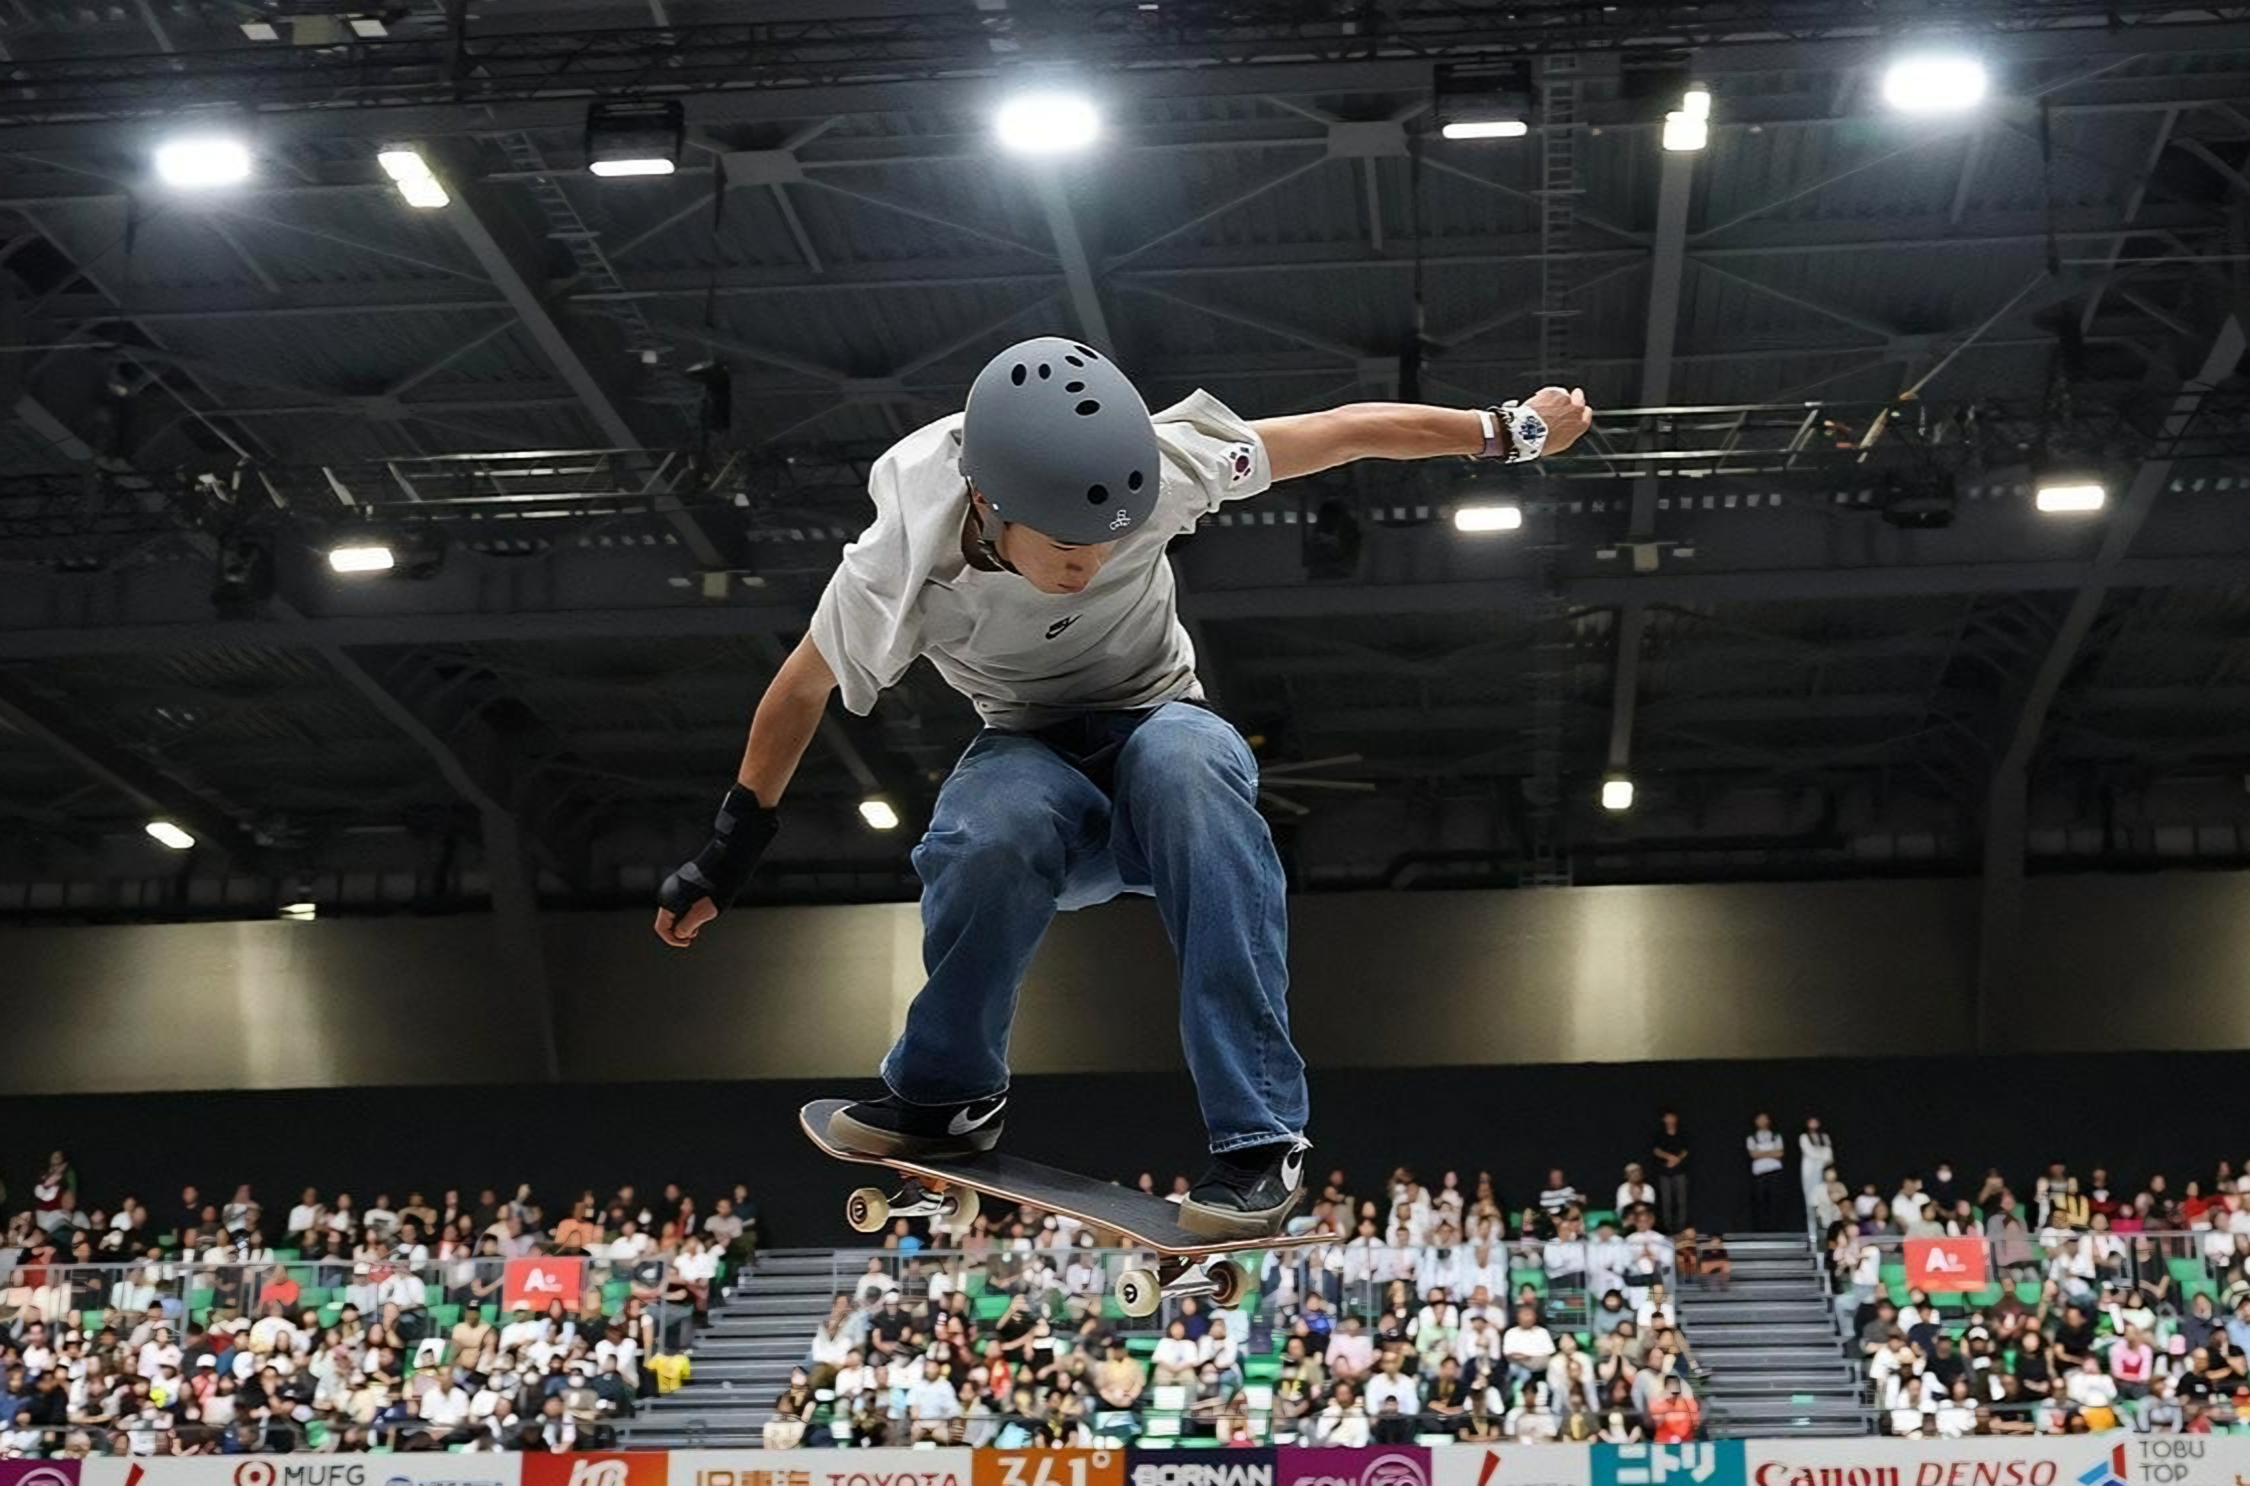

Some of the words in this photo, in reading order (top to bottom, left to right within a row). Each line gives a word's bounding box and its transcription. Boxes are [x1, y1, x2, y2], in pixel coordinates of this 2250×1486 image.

[2138, 1440, 2205, 1459] TOBU
[284, 1464, 365, 1486] MUFG
[1616, 1443, 1716, 1484] ニトリ
[1755, 1460, 1899, 1486] Canon
[1915, 1460, 2057, 1486] DENSO
